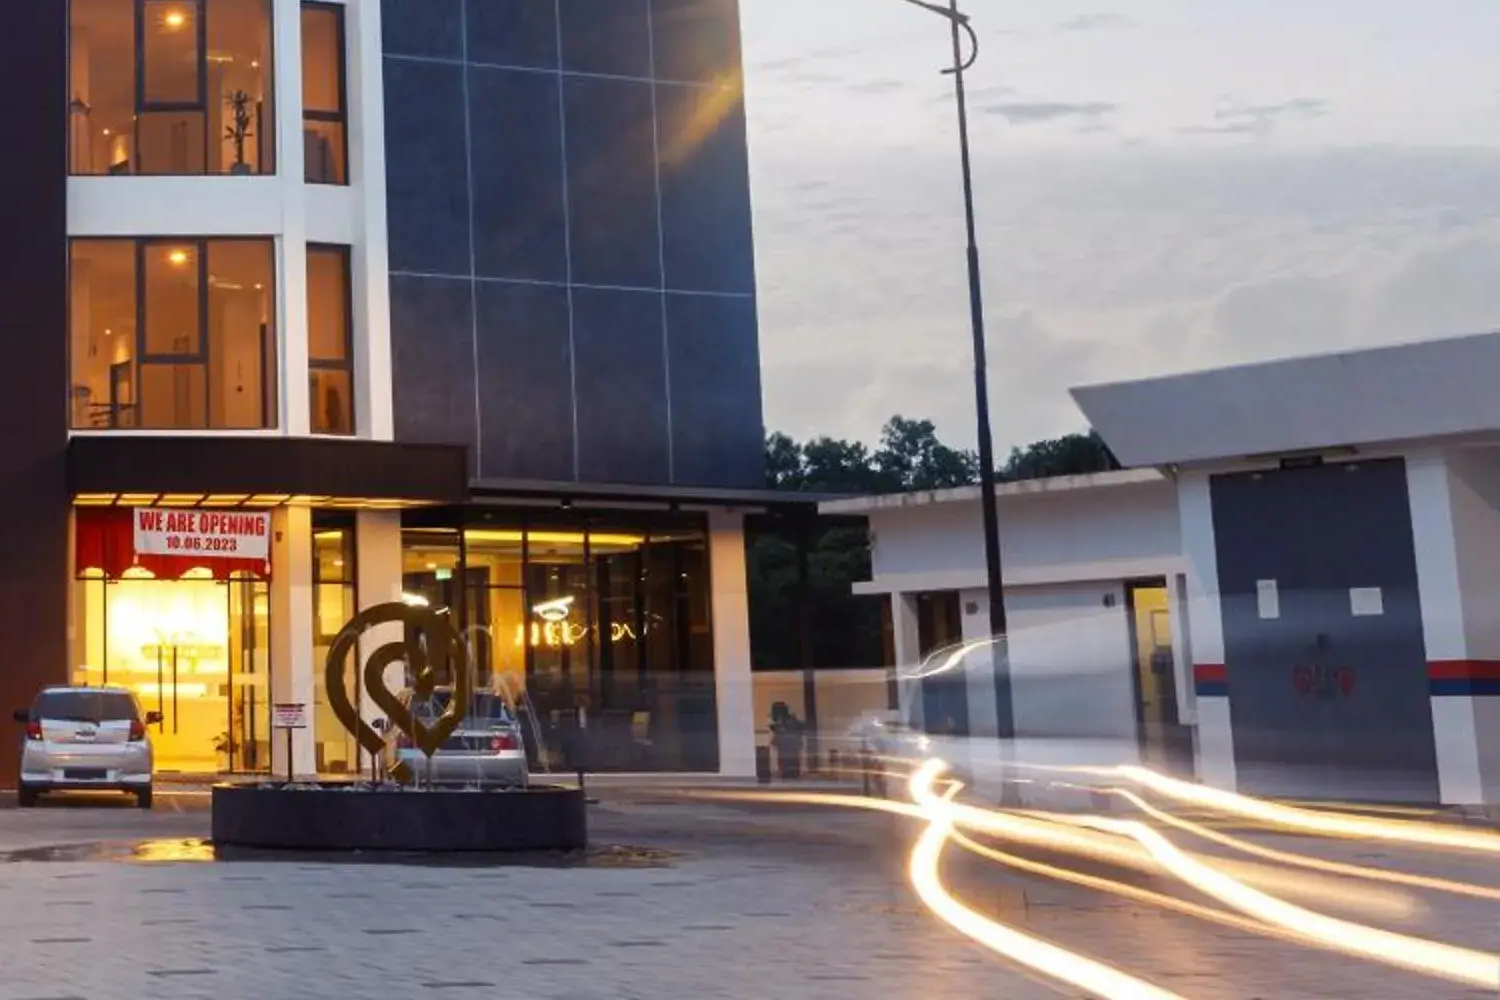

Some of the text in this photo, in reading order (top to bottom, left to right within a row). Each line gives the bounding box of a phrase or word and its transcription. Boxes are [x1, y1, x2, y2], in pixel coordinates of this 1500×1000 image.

[140, 511, 265, 536] WE ARE OPENING
